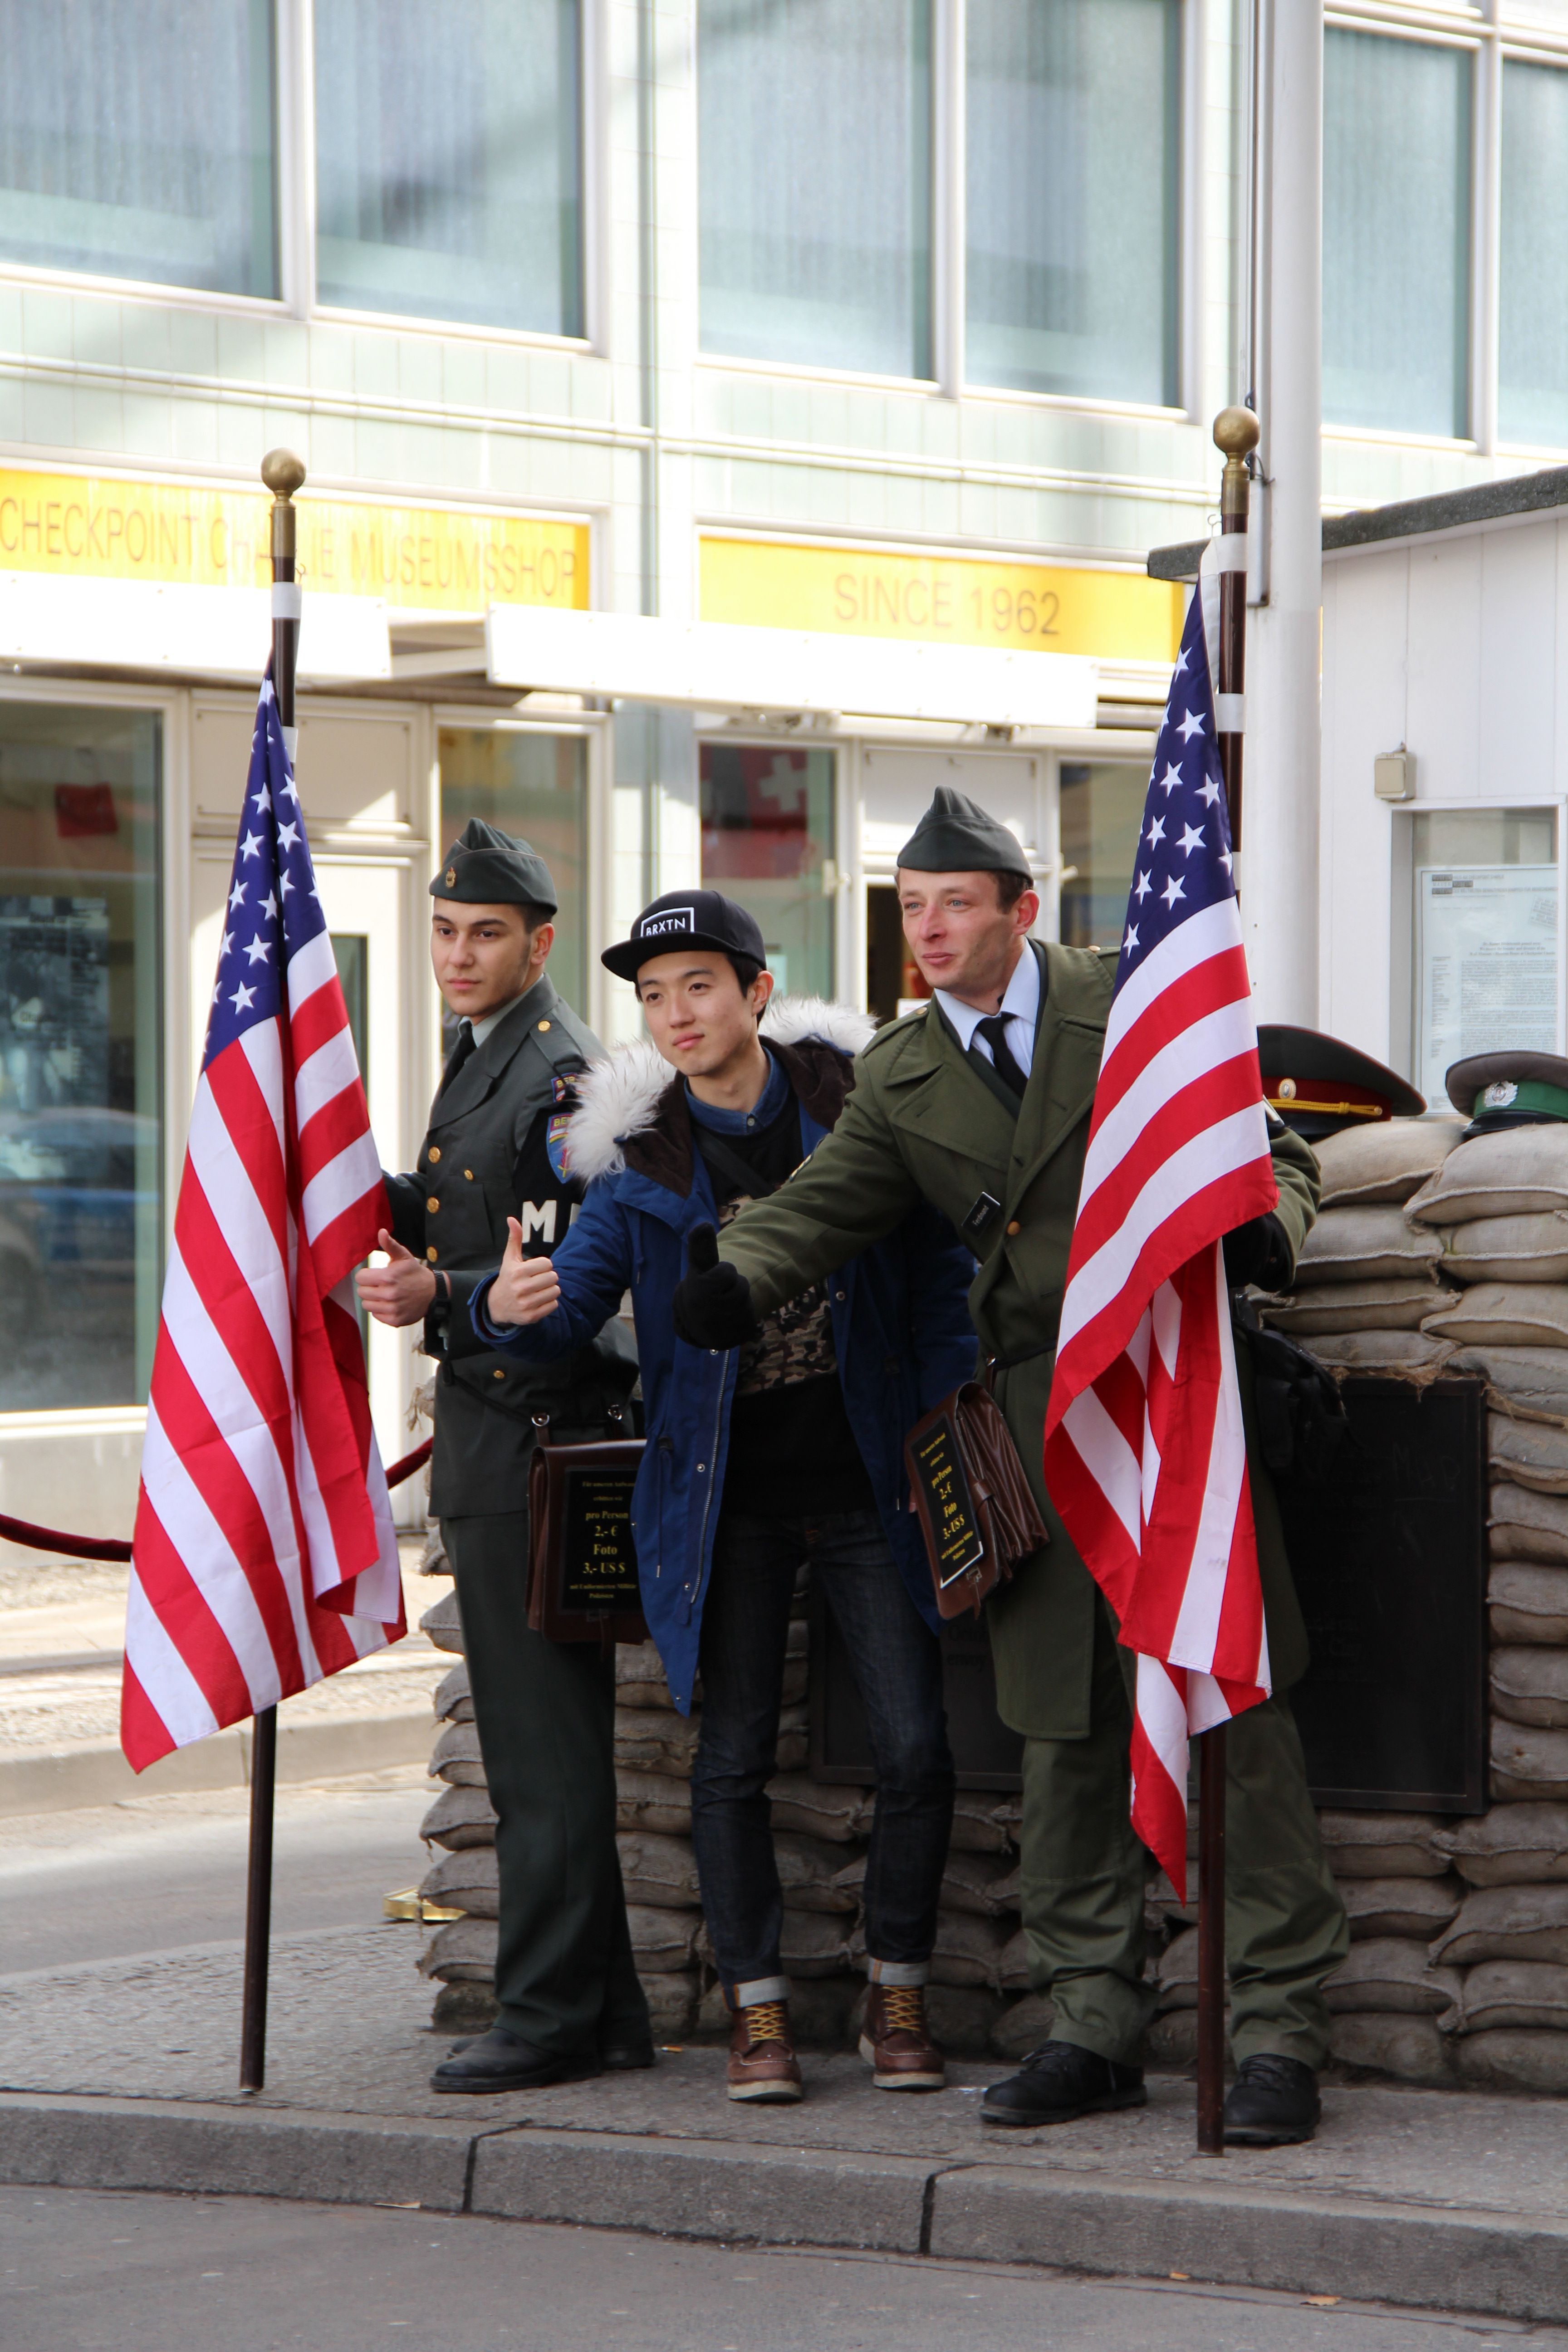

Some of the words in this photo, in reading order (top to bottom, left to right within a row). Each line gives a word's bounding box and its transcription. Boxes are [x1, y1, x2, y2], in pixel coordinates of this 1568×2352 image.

[0, 497, 198, 565] CHECKPOINT
[210, 517, 334, 578] CHALIE
[351, 529, 577, 597] MUSEUMSSHOP
[834, 573, 952, 627] SINCE
[971, 586, 1060, 635] 1962
[646, 917, 686, 936] BRXTN
[585, 1513, 600, 1521] pro
[602, 1510, 629, 1519] Person
[943, 1502, 957, 1518] Foto
[593, 1544, 617, 1555] Foto
